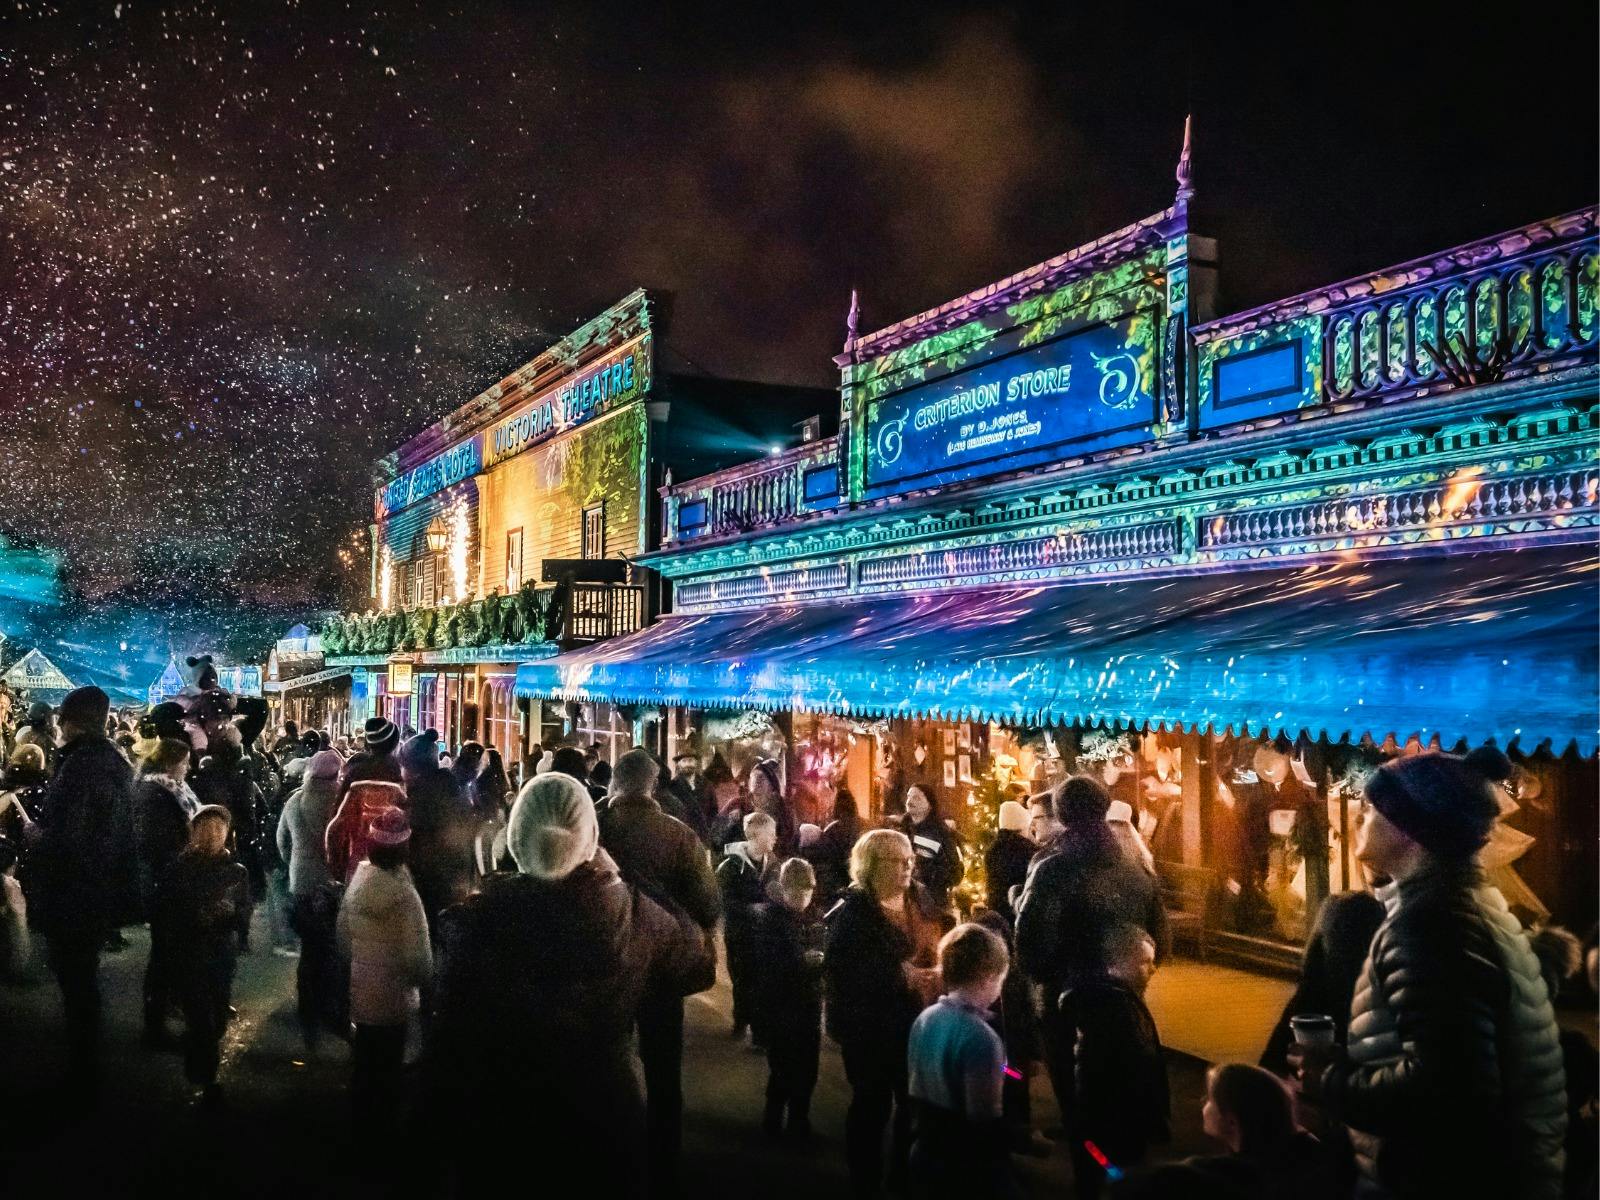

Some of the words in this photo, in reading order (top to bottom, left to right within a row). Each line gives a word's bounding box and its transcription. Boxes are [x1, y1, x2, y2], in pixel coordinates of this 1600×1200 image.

[494, 401, 554, 455] VICTORIA
[562, 356, 635, 422] THEATRE
[914, 381, 1000, 430] CRITERION
[1007, 365, 1071, 401] STORE
[960, 424, 975, 438] BY
[445, 443, 477, 485] HOTEL
